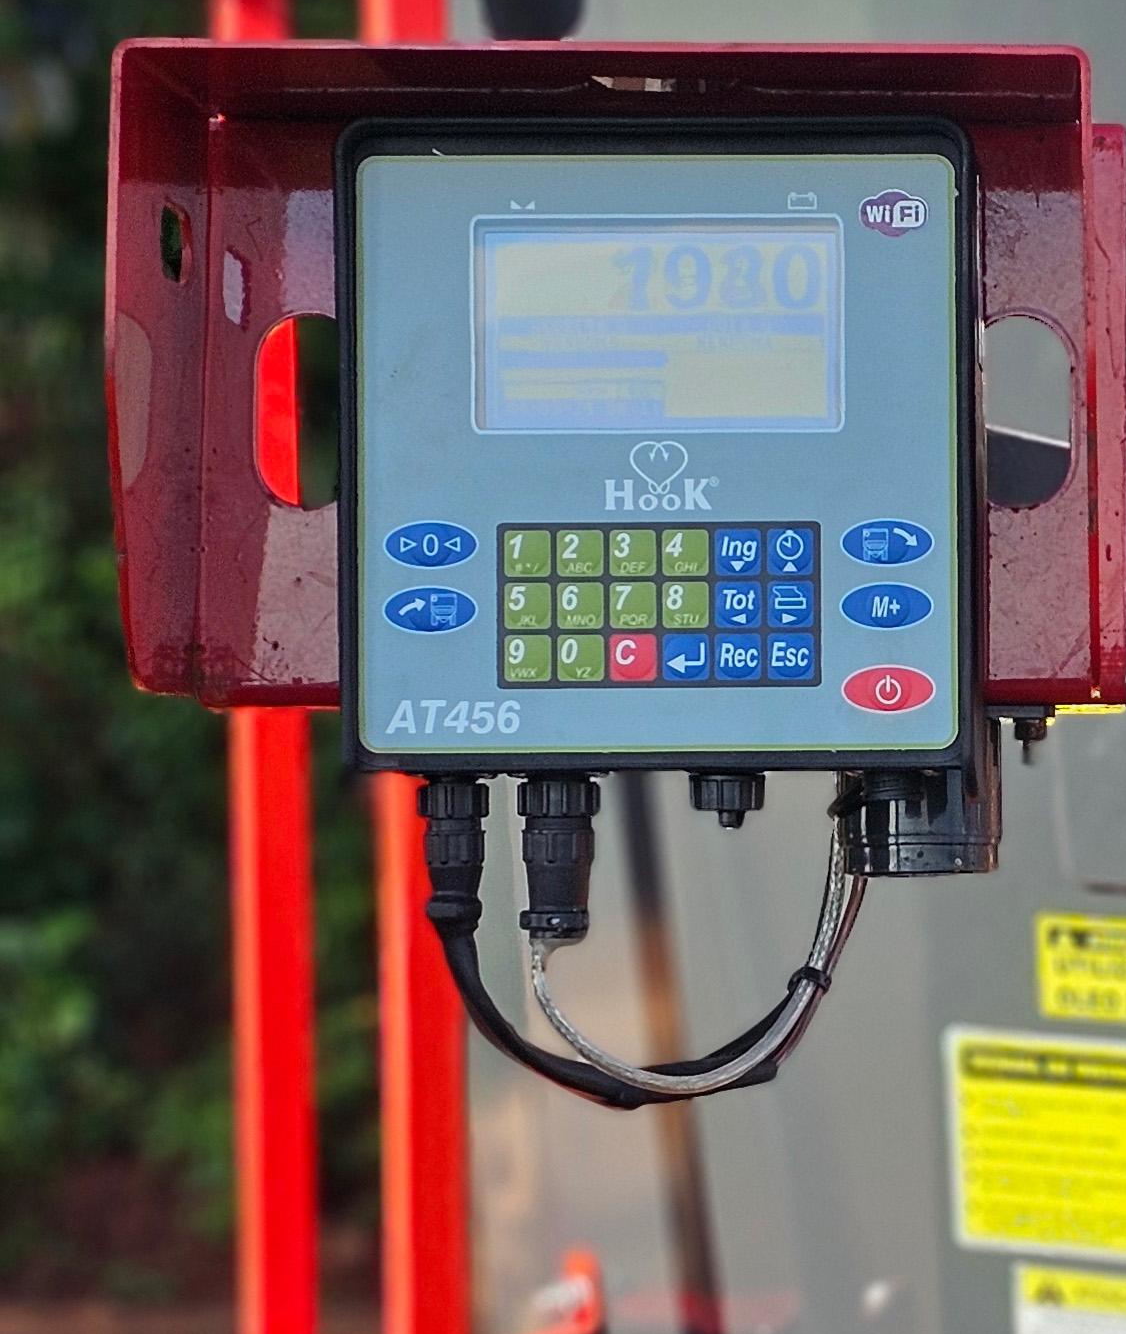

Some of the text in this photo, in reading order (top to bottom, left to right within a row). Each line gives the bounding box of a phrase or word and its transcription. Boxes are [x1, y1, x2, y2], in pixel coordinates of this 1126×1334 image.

[508, 534, 523, 559] 1
[562, 534, 579, 559] 2
[613, 533, 631, 558] 3
[665, 532, 683, 557] 4
[721, 536, 757, 562] Ing
[565, 562, 593, 573] ABC
[620, 562, 646, 573] DEF
[674, 561, 698, 573] GHI
[508, 586, 526, 611] 5
[561, 585, 579, 611] 6
[614, 585, 632, 611] 7
[666, 584, 684, 610] 8
[722, 589, 756, 610] Tot
[872, 596, 901, 618] M+
[566, 614, 596, 626] MNO
[619, 614, 648, 626] PQR
[674, 614, 700, 625] STU
[508, 638, 525, 664] 9
[561, 638, 578, 664] 0
[615, 639, 636, 665] C
[720, 642, 758, 668] Rec
[771, 641, 809, 667] Esc
[575, 666, 592, 678] YZ
[385, 699, 521, 734] AT456
